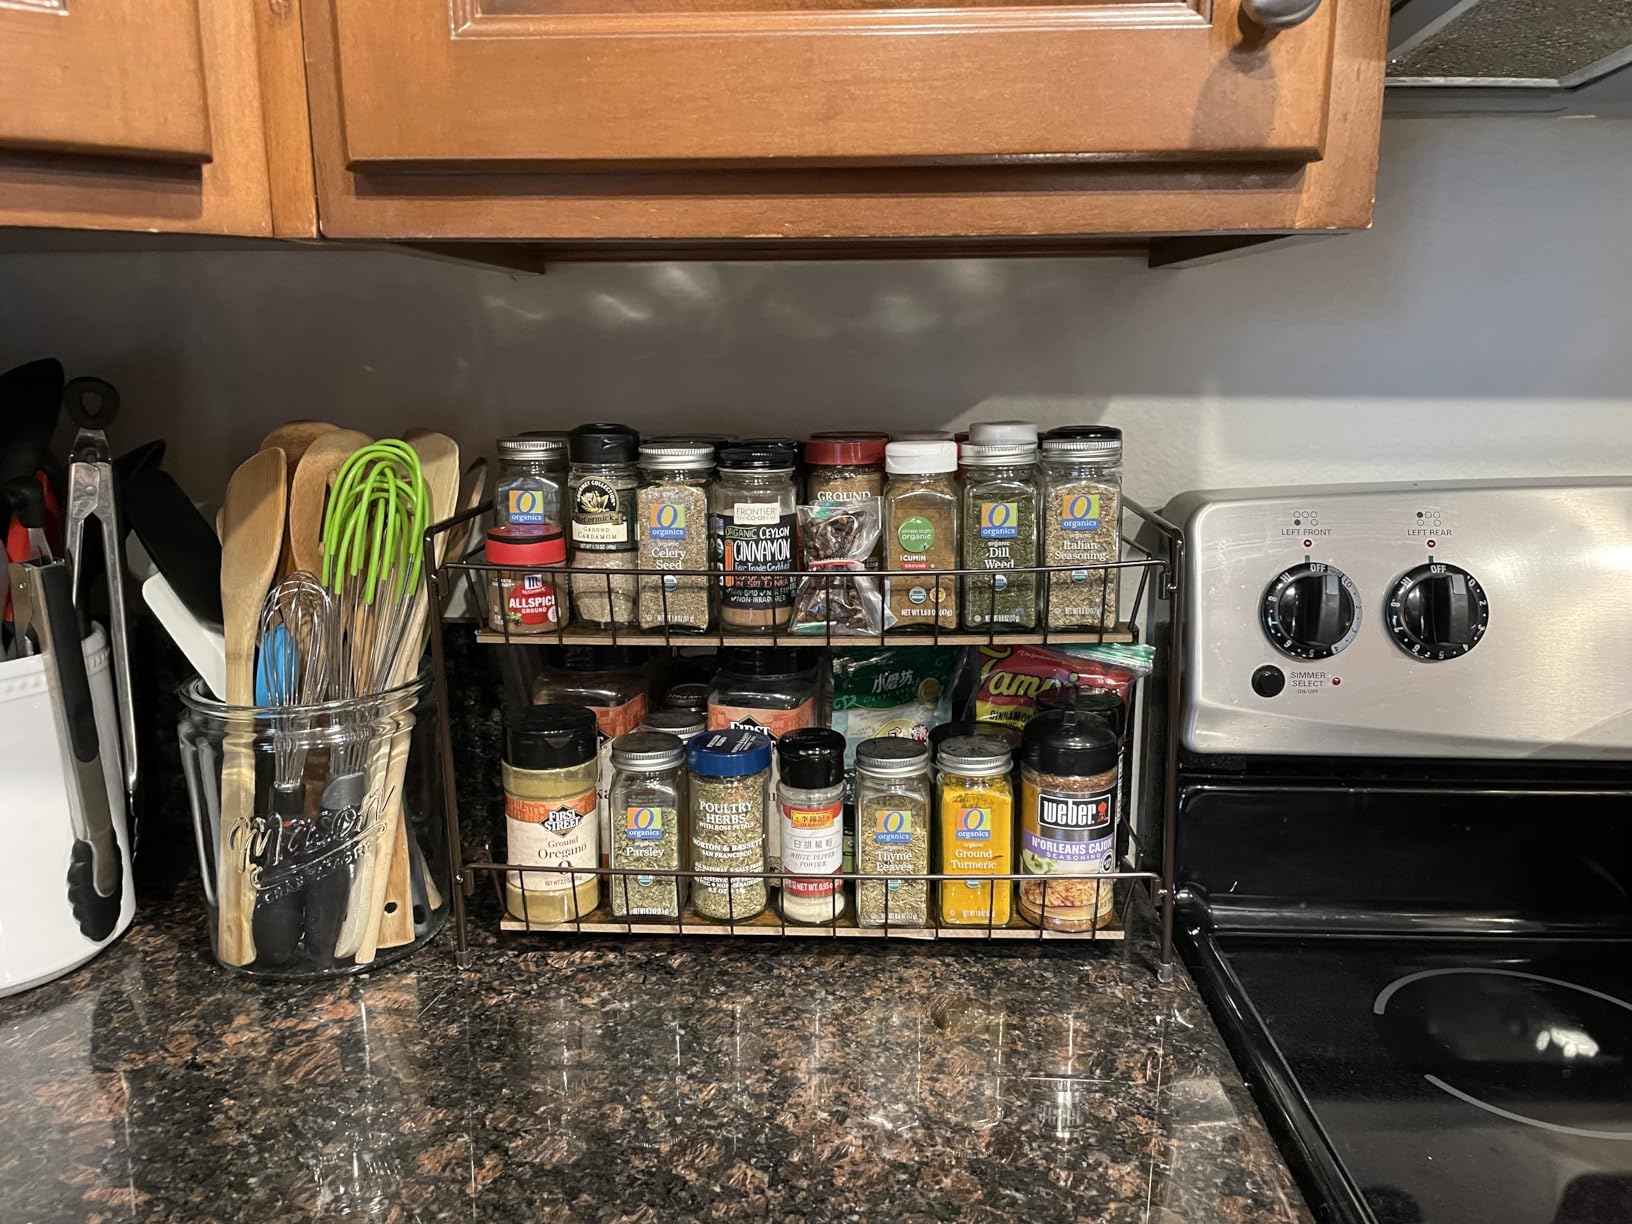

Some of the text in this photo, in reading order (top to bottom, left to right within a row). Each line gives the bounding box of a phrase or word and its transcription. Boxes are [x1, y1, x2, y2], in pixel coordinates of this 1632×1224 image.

[817, 490, 871, 501] GROUND
[736, 507, 775, 516] FRONTIER
[511, 514, 542, 523] organics
[1063, 520, 1097, 528] organics
[577, 531, 617, 540] CARDAMOM
[651, 528, 684, 537] organics
[725, 525, 790, 539] ORGANIC CEYLON
[982, 527, 1016, 536] organics
[901, 533, 932, 541] organic
[733, 538, 791, 562] CINNAMON
[1063, 540, 1098, 550] Italian
[651, 547, 687, 560] Celery
[989, 547, 1010, 558] Dill
[1054, 550, 1107, 561] Seasoning
[902, 554, 927, 562] CUMIN
[655, 560, 682, 570] Seed
[984, 559, 1015, 569] Weed
[1309, 563, 1326, 572] OFF
[1430, 564, 1447, 574] OFF
[521, 606, 547, 614] GROUND
[901, 608, 910, 616] NET
[1290, 671, 1326, 679] SIMMER
[1292, 680, 1324, 688] SELECT
[699, 800, 753, 814] POULTRY
[549, 809, 577, 822] FIRST
[705, 812, 746, 825] HERBS
[543, 817, 581, 832] STREET
[628, 830, 660, 838] organics
[878, 832, 909, 842] organics
[958, 830, 990, 839] organics
[547, 835, 579, 849] Ground
[1031, 836, 1113, 855] N'ORLEANS CAJUN
[537, 843, 587, 860] Oregano
[625, 846, 665, 858] Parsley
[722, 844, 731, 852] &
[955, 848, 993, 858] Ground
[702, 850, 752, 859] SAN FRANCISCO
[790, 850, 836, 861] WHITE PEPPER
[877, 852, 913, 863] Thyme
[1046, 852, 1101, 861] SEASONING
[876, 862, 913, 872] Leaves
[950, 860, 997, 870] Turmeric
[797, 882, 808, 891] NET
